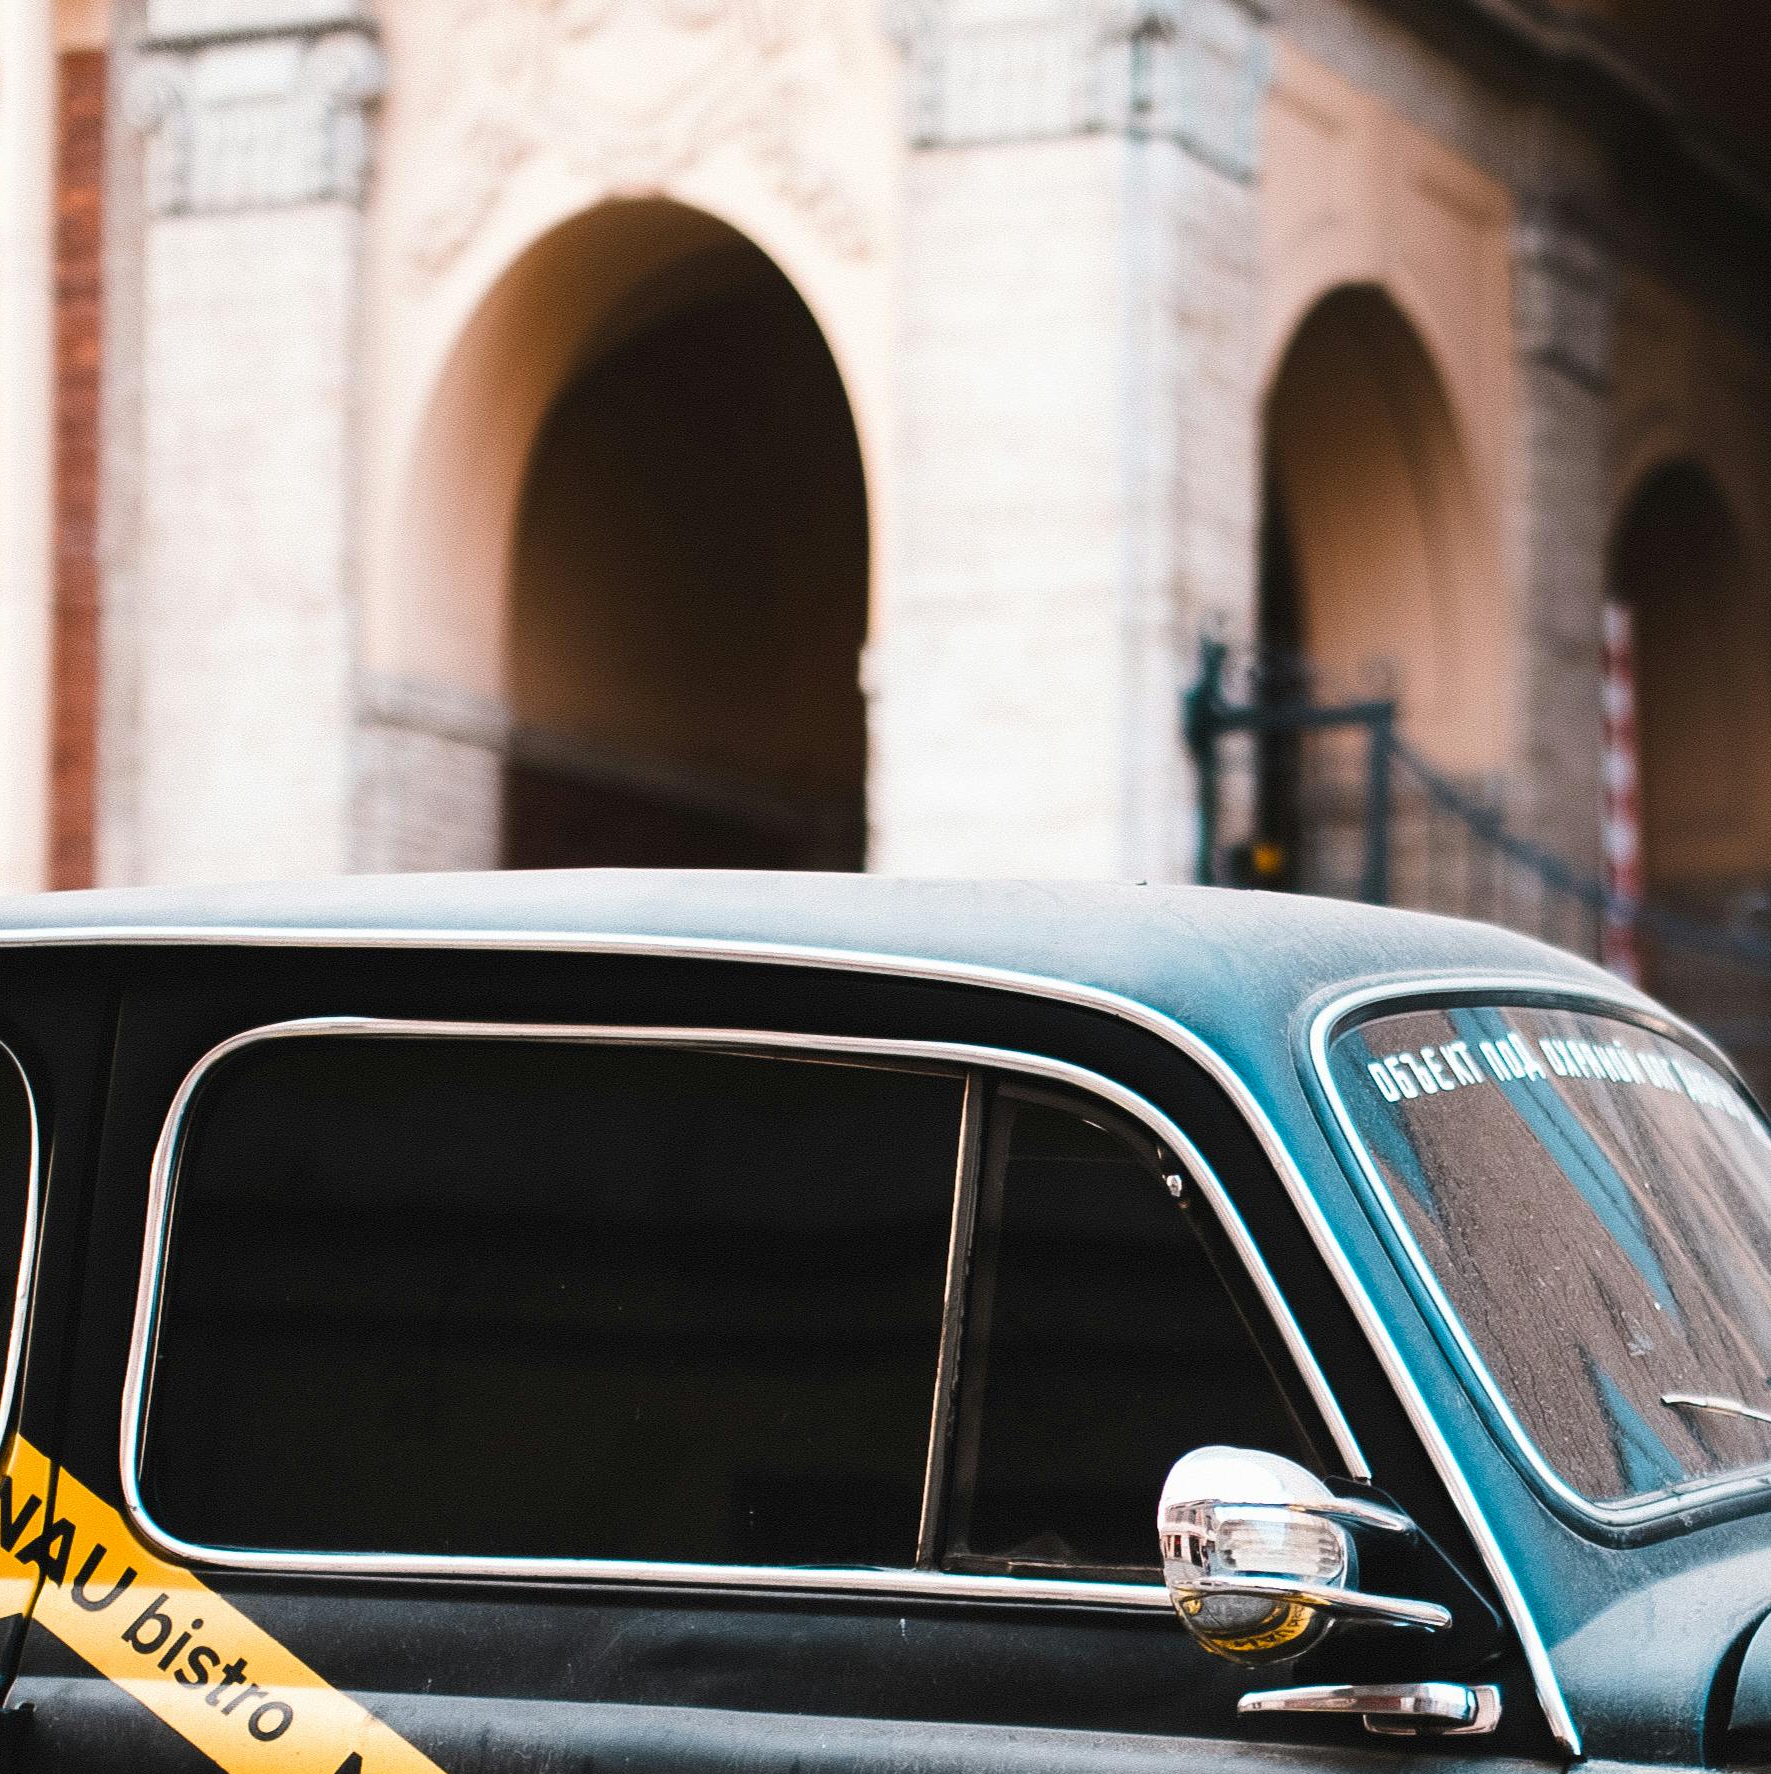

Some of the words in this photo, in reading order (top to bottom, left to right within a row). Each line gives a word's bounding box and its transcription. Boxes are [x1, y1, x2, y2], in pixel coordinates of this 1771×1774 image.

[1368, 1041, 1486, 1102] ОБЪЕКТ
[1479, 1032, 1548, 1082] ПОД
[121, 1594, 294, 1742] bistro
